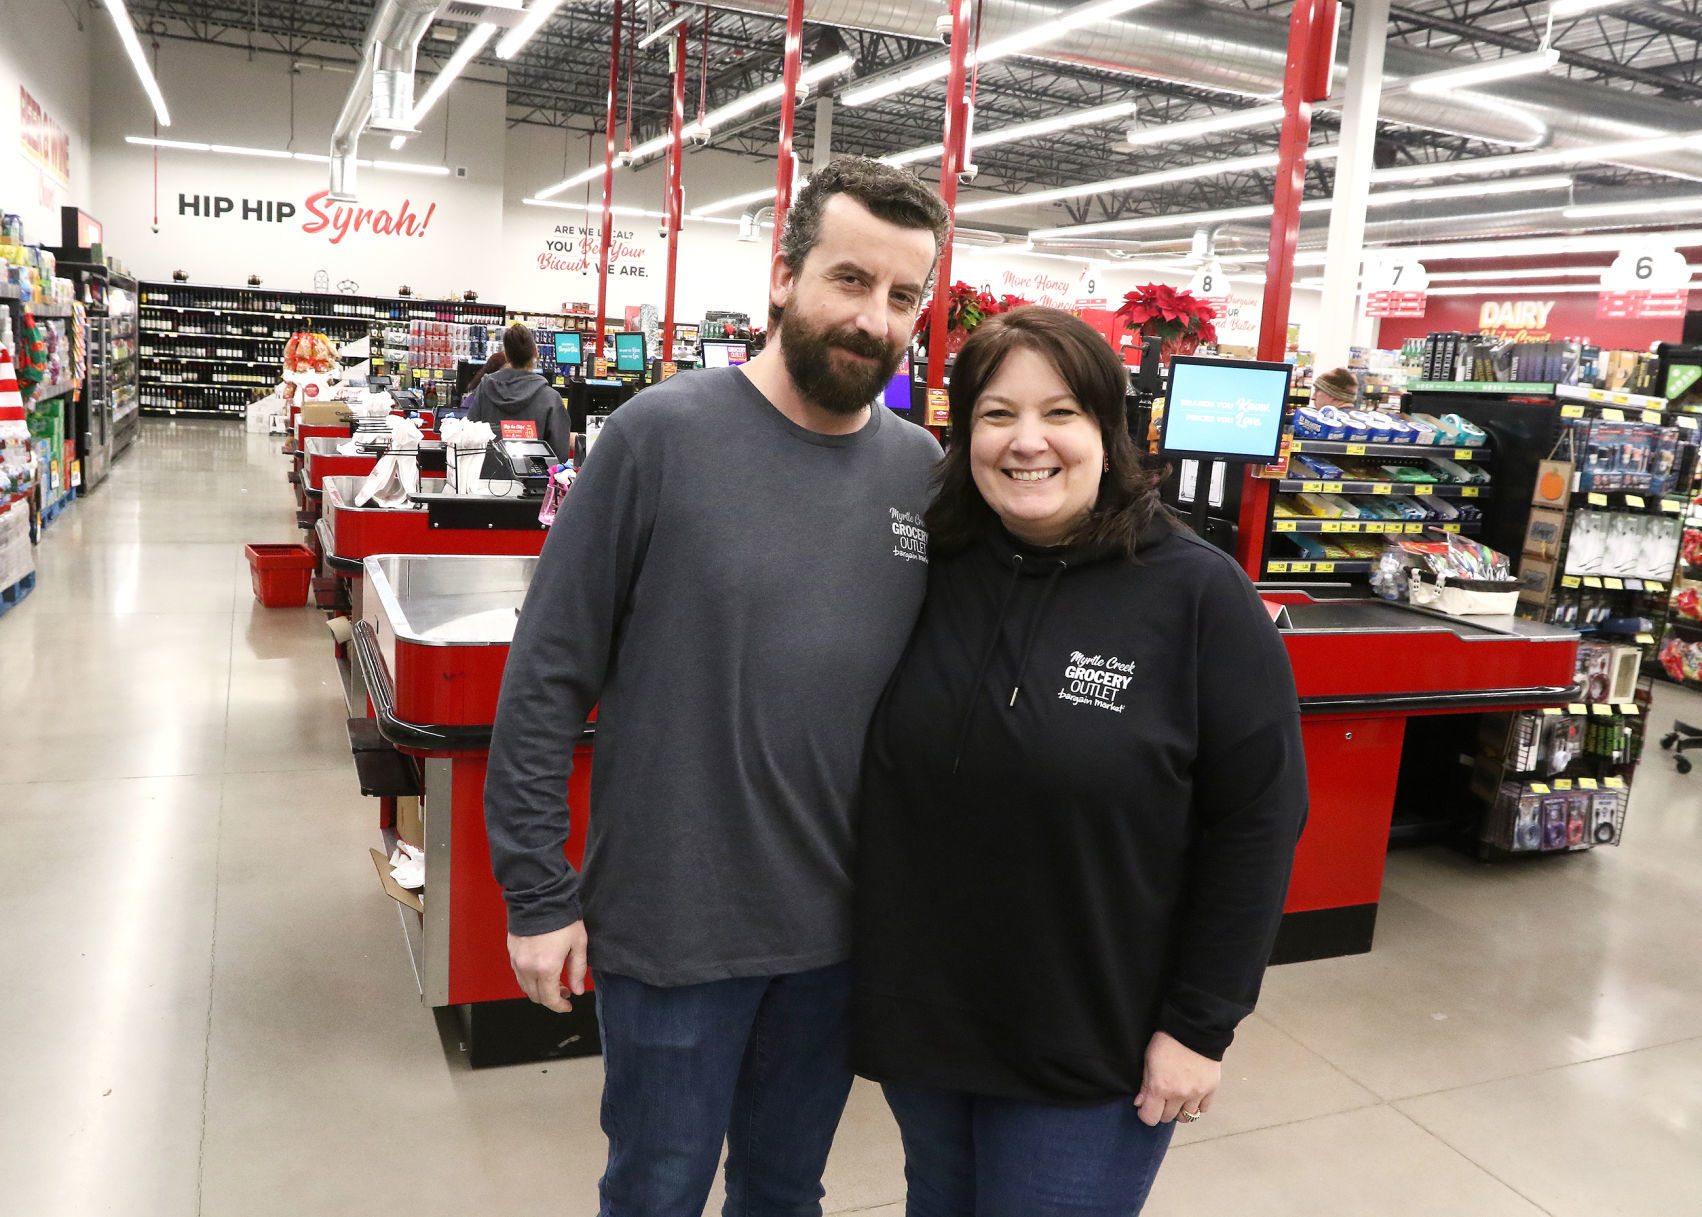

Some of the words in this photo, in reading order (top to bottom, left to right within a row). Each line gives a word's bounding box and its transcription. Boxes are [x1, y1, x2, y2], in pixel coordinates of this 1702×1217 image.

[178, 193, 235, 218] HIP
[241, 198, 296, 223] HIP
[301, 189, 437, 245] Syrah!
[554, 225, 575, 235] ARE
[578, 227, 594, 236] WE
[597, 228, 634, 239] LAL?
[546, 240, 573, 252] YOU
[578, 237, 602, 255] Be
[609, 240, 645, 262] Your
[537, 252, 591, 273] Biscuit
[620, 265, 649, 278] ARE.
[1393, 266, 1404, 285] 7
[1636, 256, 1653, 280] 6
[1002, 270, 1031, 288] More
[1034, 274, 1070, 295] Honey
[1087, 279, 1095, 294] 9
[1202, 275, 1213, 292] 8
[1227, 308, 1240, 317] UR
[1479, 301, 1556, 329] DAIRY
[1510, 356, 1519, 381] SATELLITE
[1216, 401, 1234, 409] YOU
[1216, 416, 1234, 424] YOU
[889, 507, 914, 523] Myrtle
[893, 545, 918, 561] bargain
[900, 536, 926, 555] OUTLET
[1070, 650, 1105, 668] Myrtle
[1105, 656, 1136, 675] Creek
[1064, 665, 1133, 690] GROCERY
[1057, 687, 1093, 706] bargain
[1094, 699, 1125, 713] market
[1070, 680, 1119, 702] OUTLET
